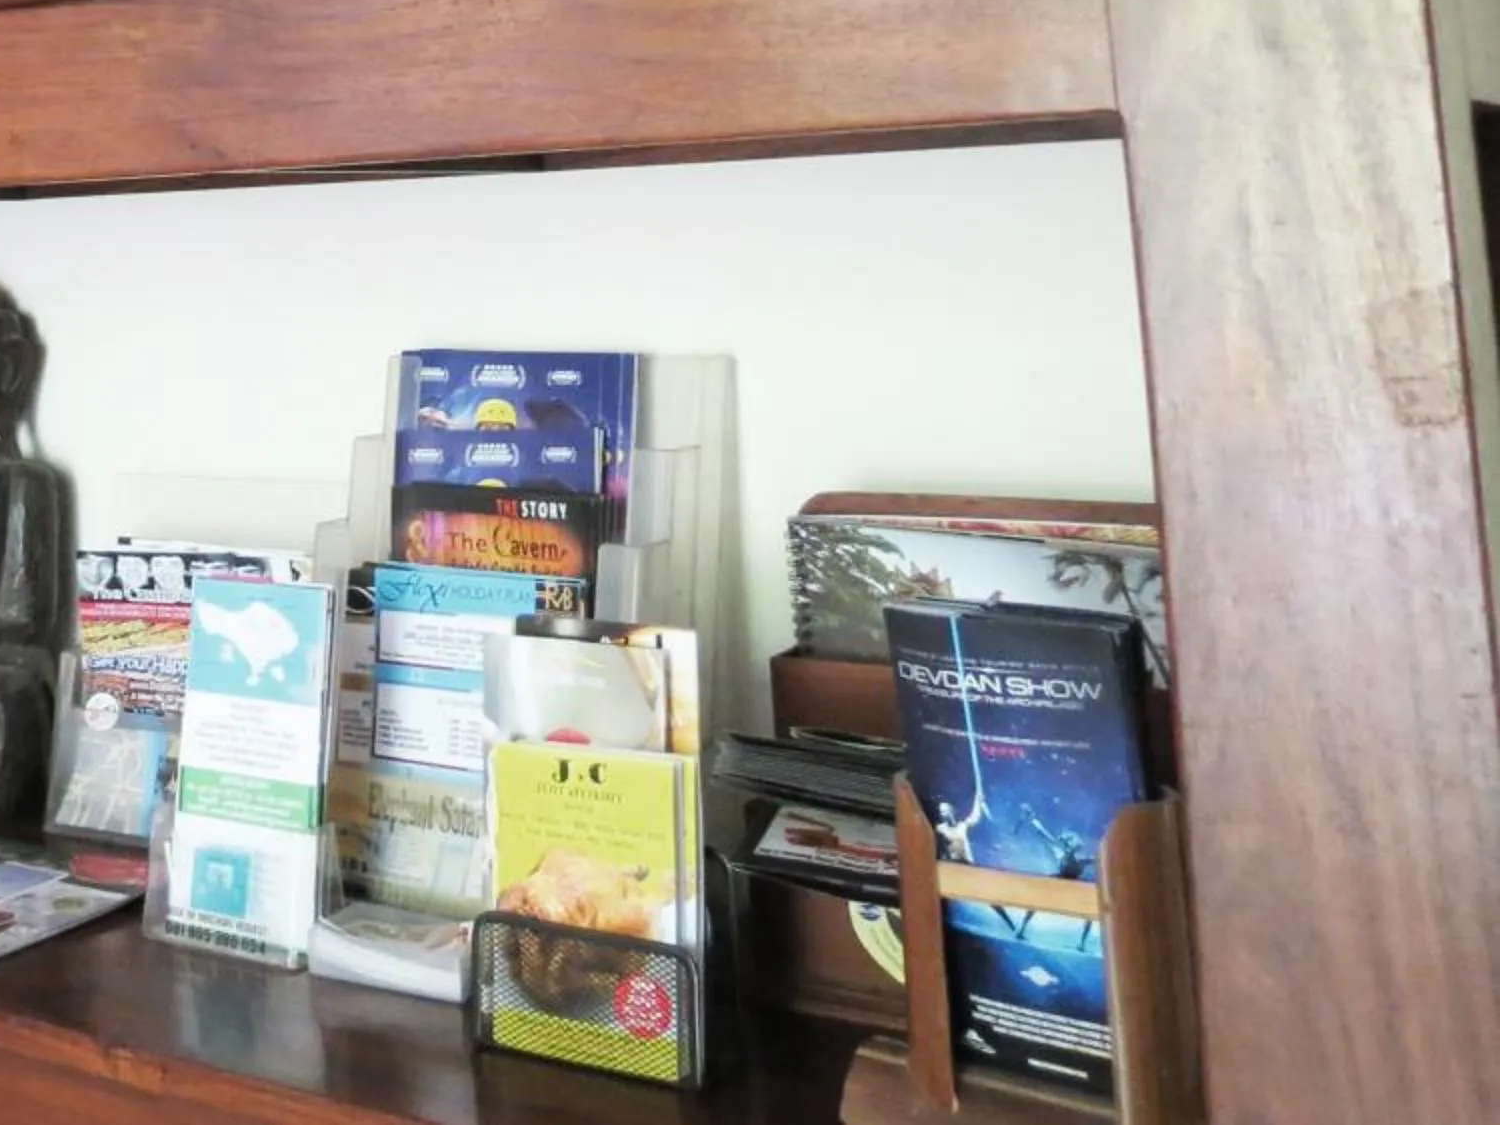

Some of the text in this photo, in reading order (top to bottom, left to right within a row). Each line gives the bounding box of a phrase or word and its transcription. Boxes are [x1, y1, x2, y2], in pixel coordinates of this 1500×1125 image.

[520, 500, 568, 520] STORY
[448, 531, 489, 554] The
[896, 659, 1103, 702] DEVDAN SHOW
